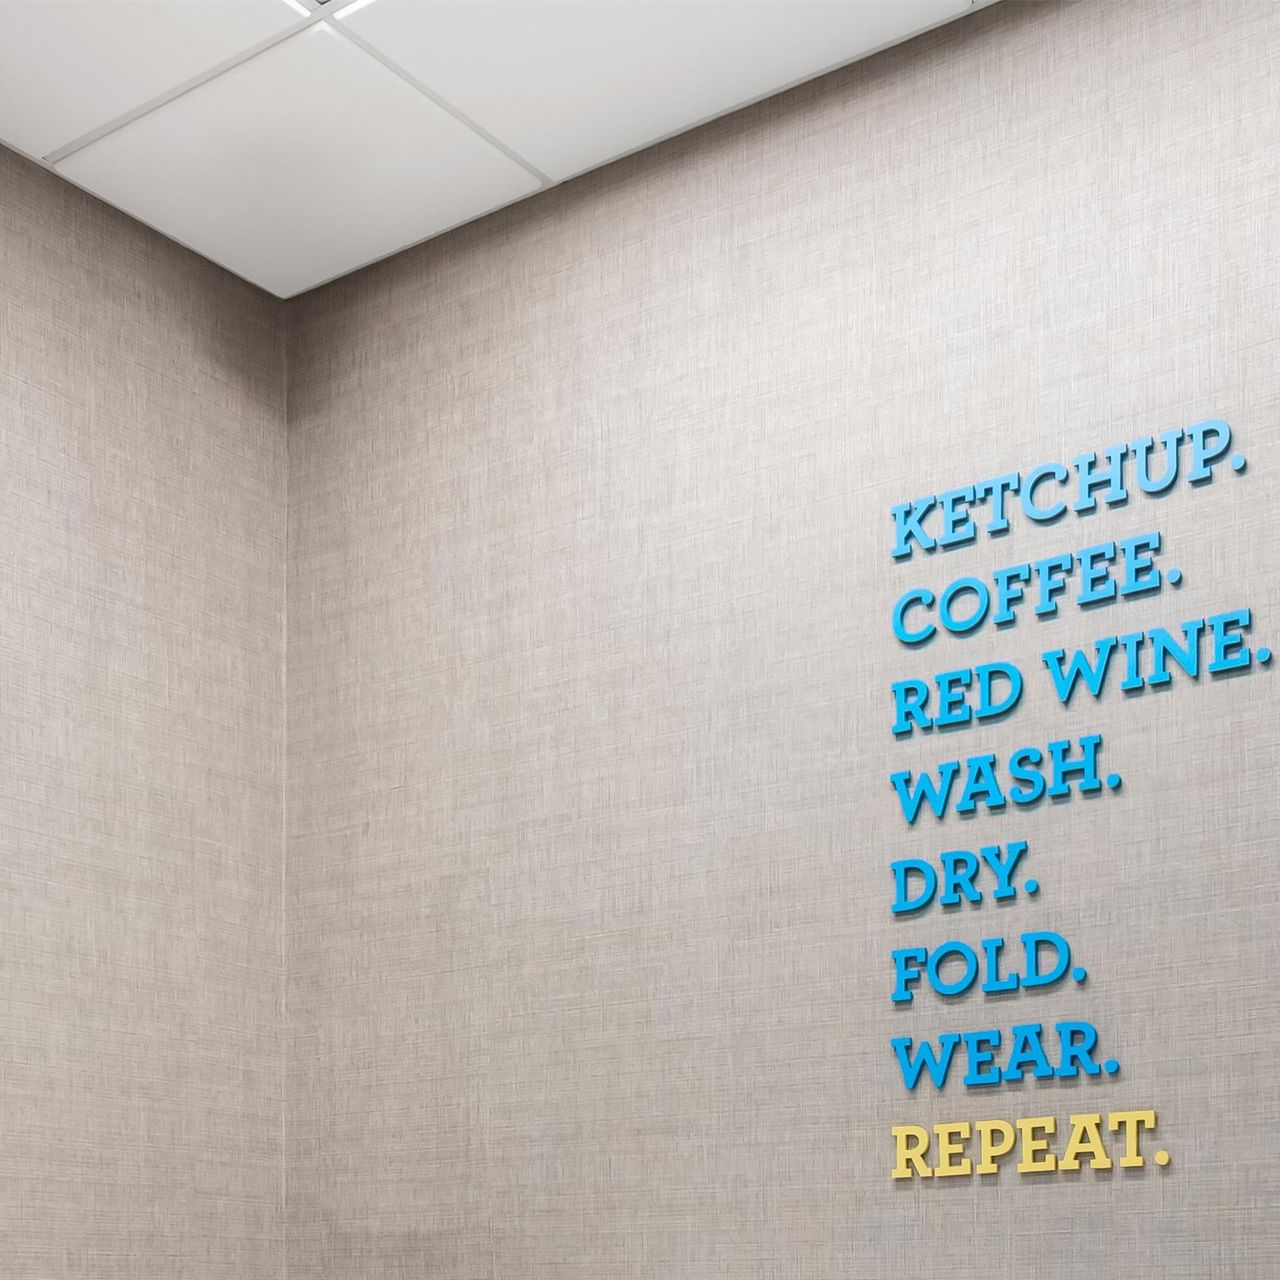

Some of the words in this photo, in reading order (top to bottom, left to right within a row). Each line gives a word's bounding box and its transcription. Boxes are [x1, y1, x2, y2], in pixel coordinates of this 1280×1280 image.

[891, 420, 1245, 559] KETCHUP.
[891, 532, 1182, 645] COFFEE.
[891, 661, 1024, 735] RED
[1040, 608, 1272, 703] WINE.
[889, 733, 1121, 824] WASH.
[889, 840, 1039, 914] DRY.
[889, 930, 1088, 1003] FOLD.
[889, 1020, 1121, 1090] WEAR.
[890, 1108, 1171, 1179] REPEAT.
